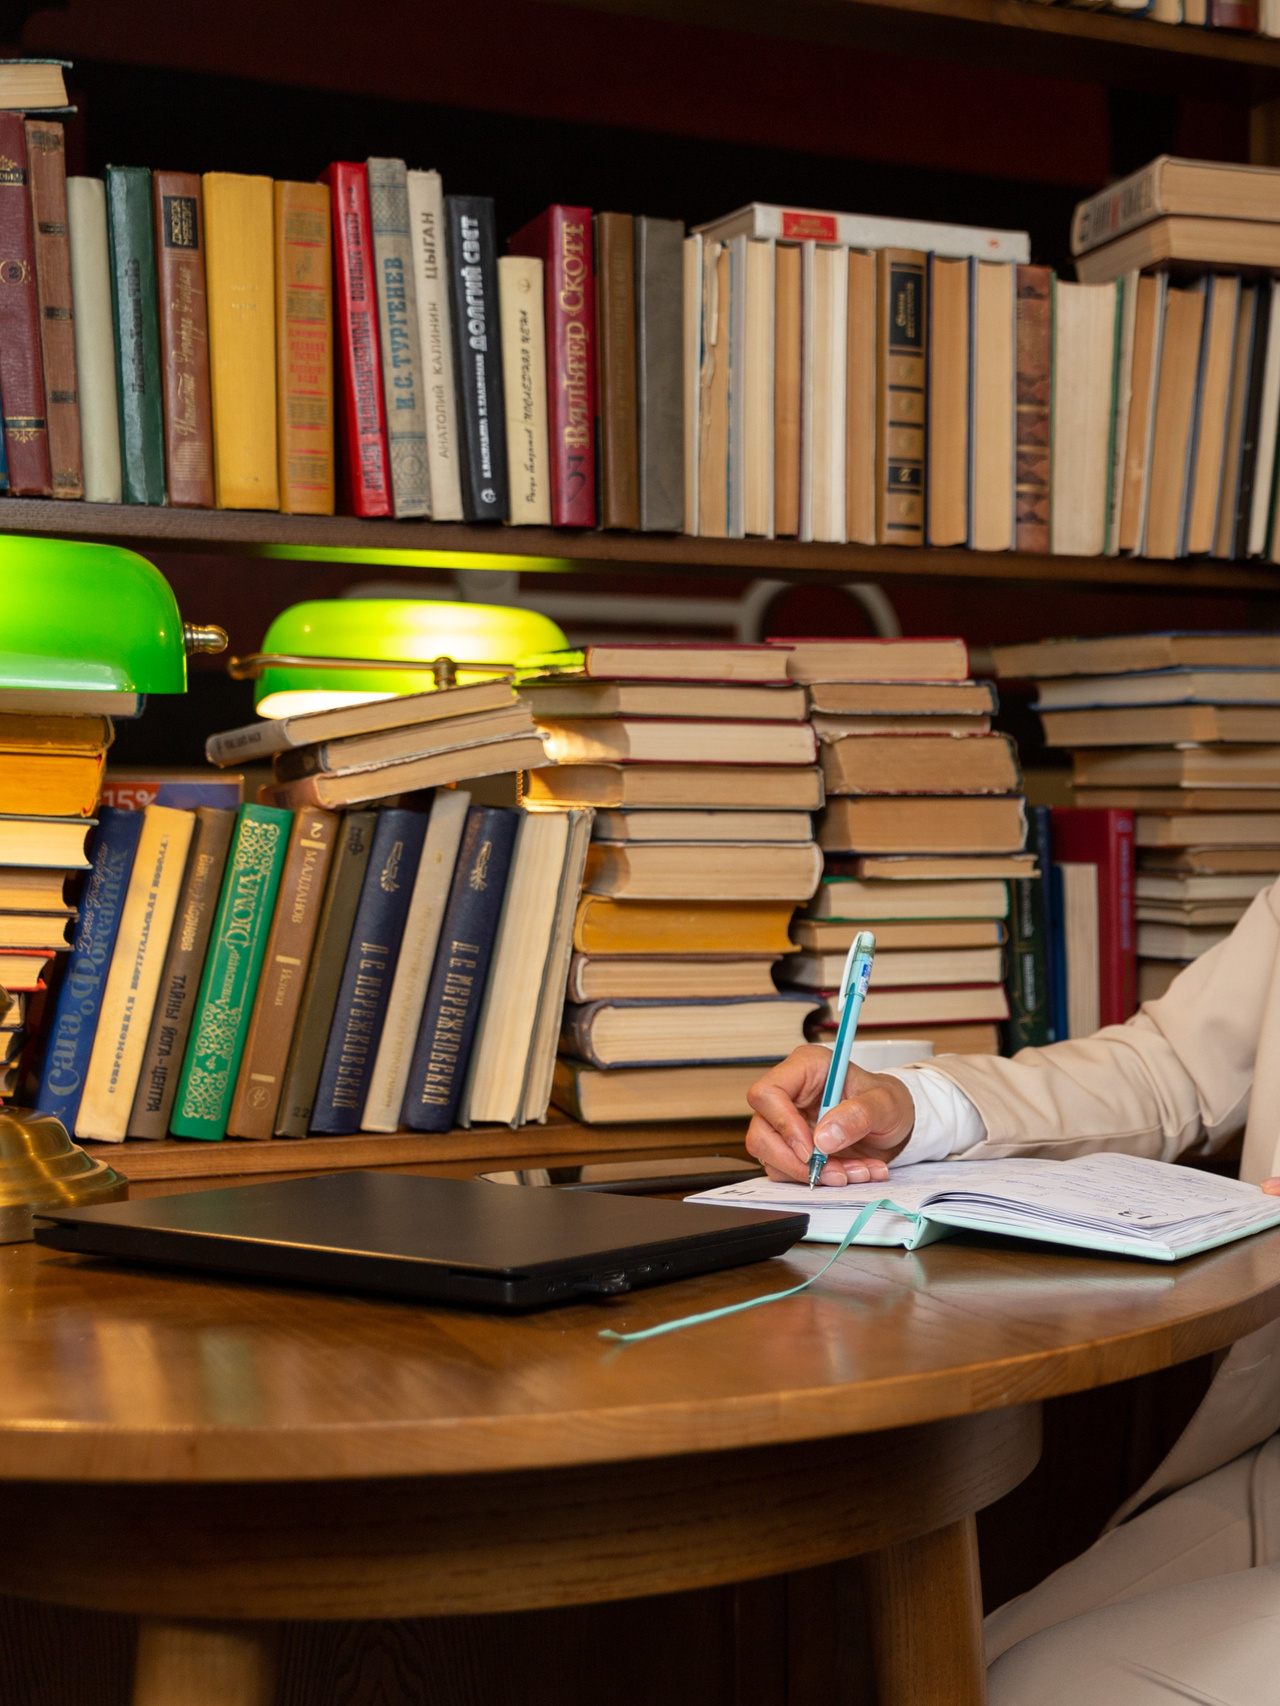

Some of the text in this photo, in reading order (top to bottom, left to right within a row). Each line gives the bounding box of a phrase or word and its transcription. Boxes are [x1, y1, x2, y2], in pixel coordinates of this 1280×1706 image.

[171, 199, 183, 245] ДЖОРДЖ
[182, 200, 194, 246] МЕРЕДИТ
[459, 215, 481, 264] СВЕТ
[8, 266, 19, 279] 2
[383, 257, 412, 369] ТУРГЕНЕВ
[461, 266, 487, 352] ДОЛГИЙ
[420, 212, 449, 458] АНАТОЛИЙ КАЛИНИН ЦЫГАН
[308, 821, 323, 838] 2
[180, 899, 205, 953] Корнеев
[46, 847, 129, 1098] Сага о Форсайтах
[165, 973, 187, 1020] ТАЙНЫ
[332, 973, 382, 1109] МЕРЕЖКОВСКИЙ
[421, 972, 472, 1108] МЕРЕЖКОВСКИЙ
[291, 1106, 309, 1118] 22
